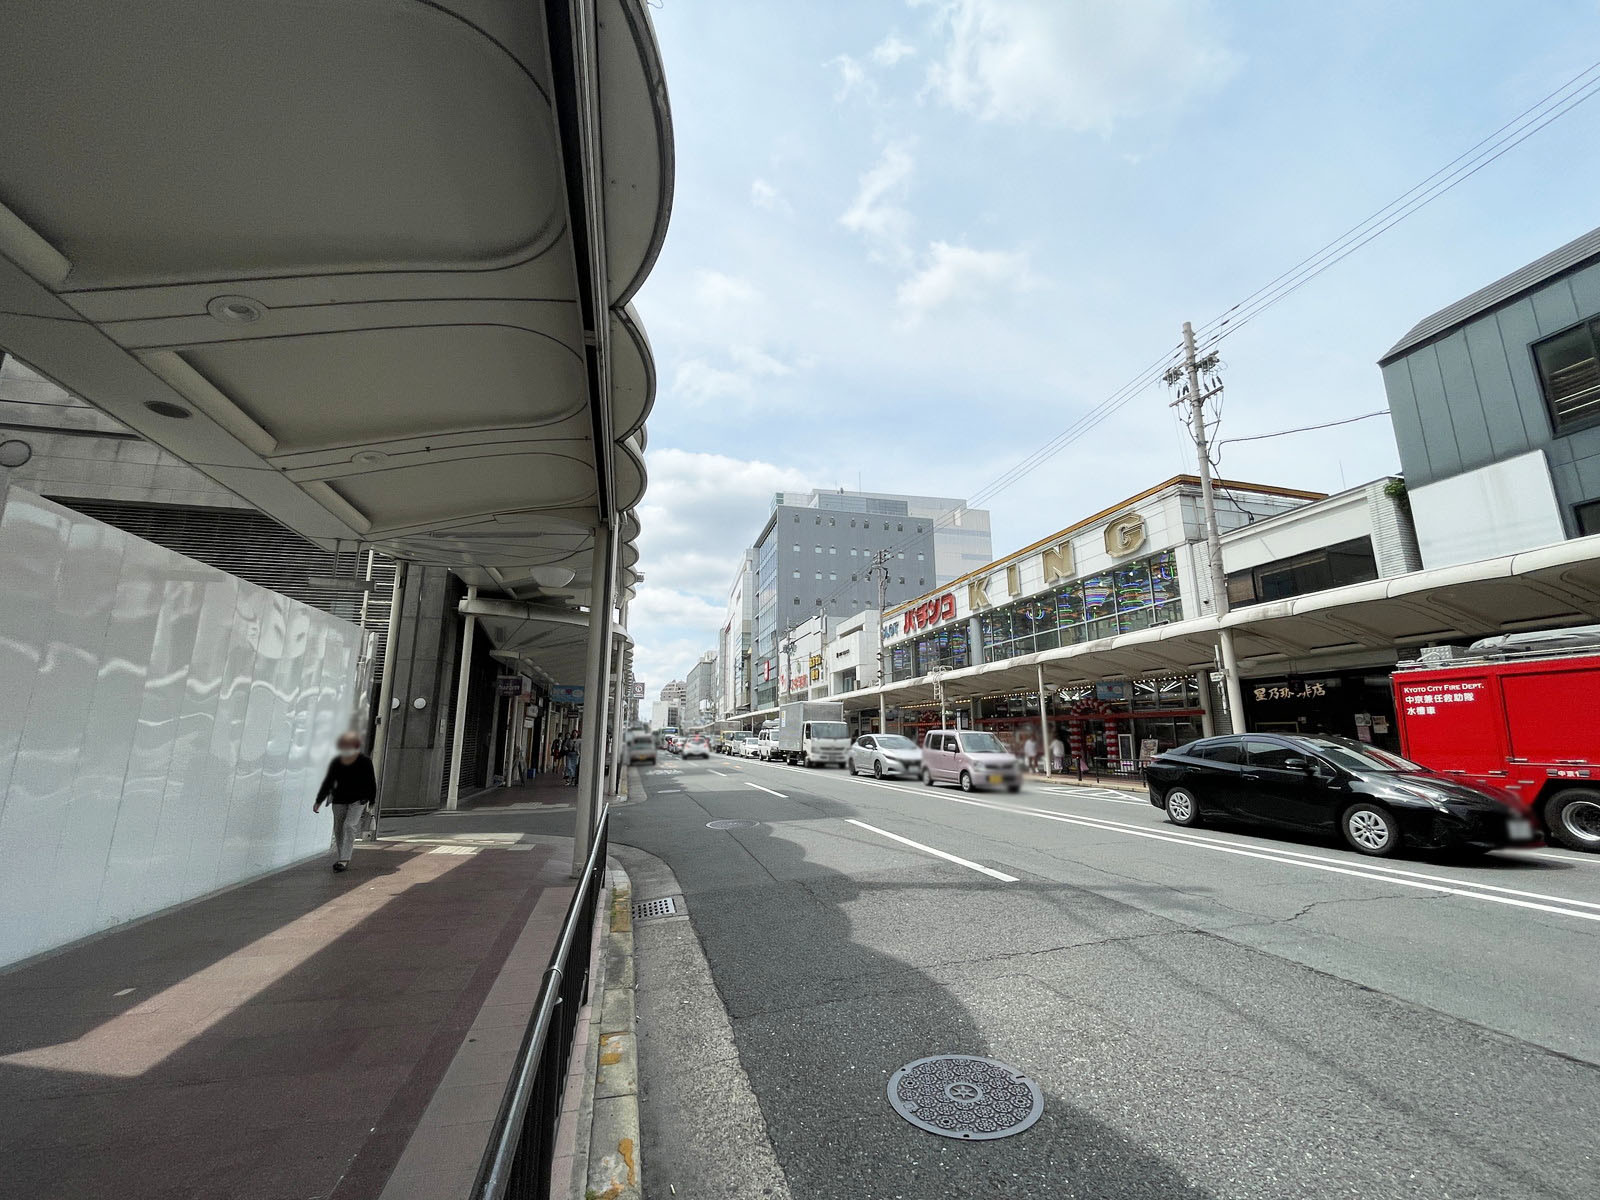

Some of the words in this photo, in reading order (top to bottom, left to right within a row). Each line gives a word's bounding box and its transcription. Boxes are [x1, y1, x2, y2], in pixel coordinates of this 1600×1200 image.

[967, 511, 1147, 611] KING
[903, 592, 957, 634] パチンコ
